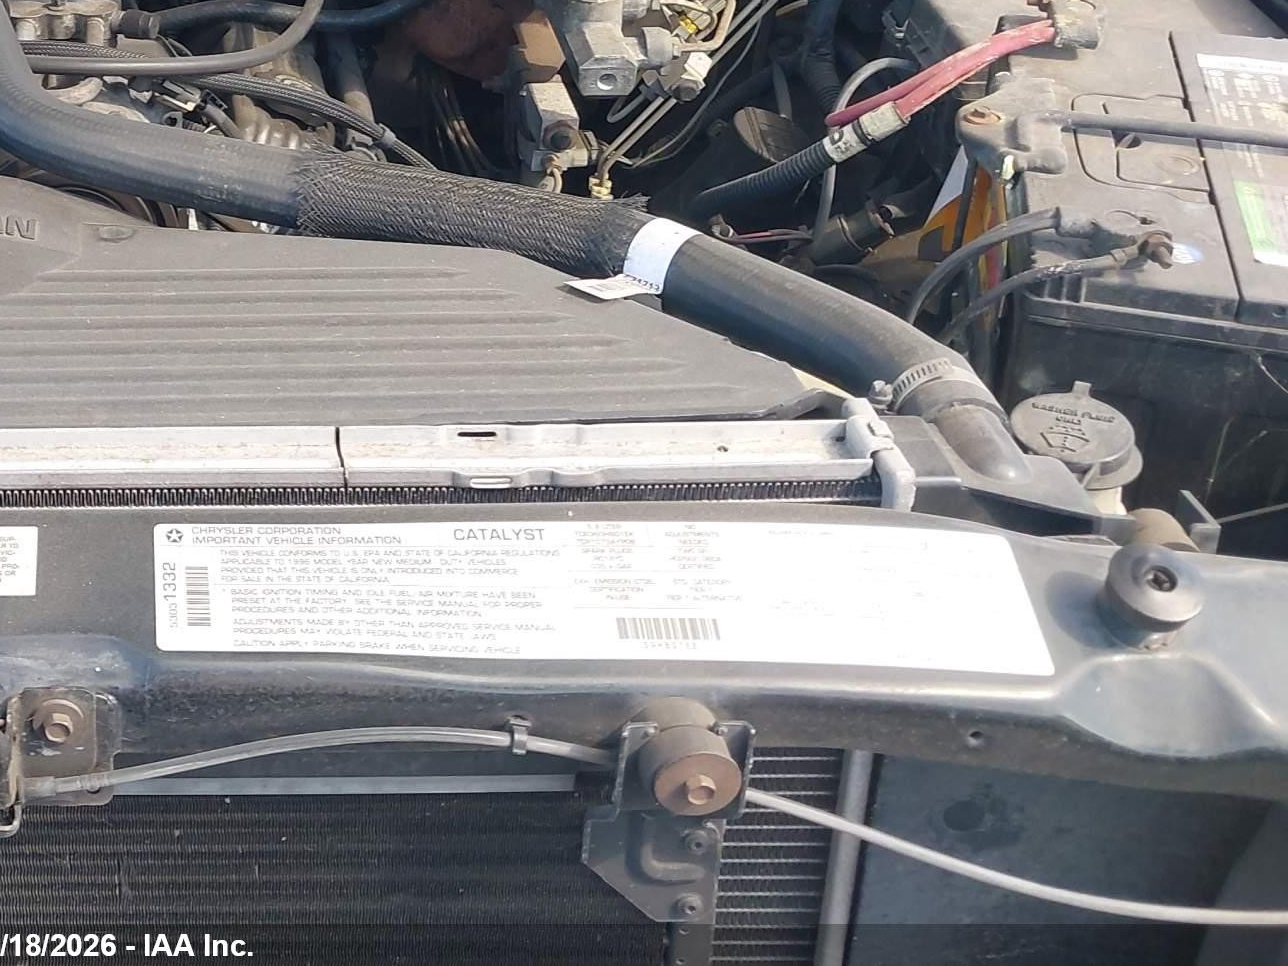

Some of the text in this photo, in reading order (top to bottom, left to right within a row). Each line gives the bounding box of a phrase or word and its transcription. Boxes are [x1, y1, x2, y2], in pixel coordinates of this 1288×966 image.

[191, 526, 342, 535] CHRYSLER CORPORATION
[453, 528, 545, 541] CATALYST
[192, 536, 402, 545] IMPORTANT VEHICLE INFORMATION
